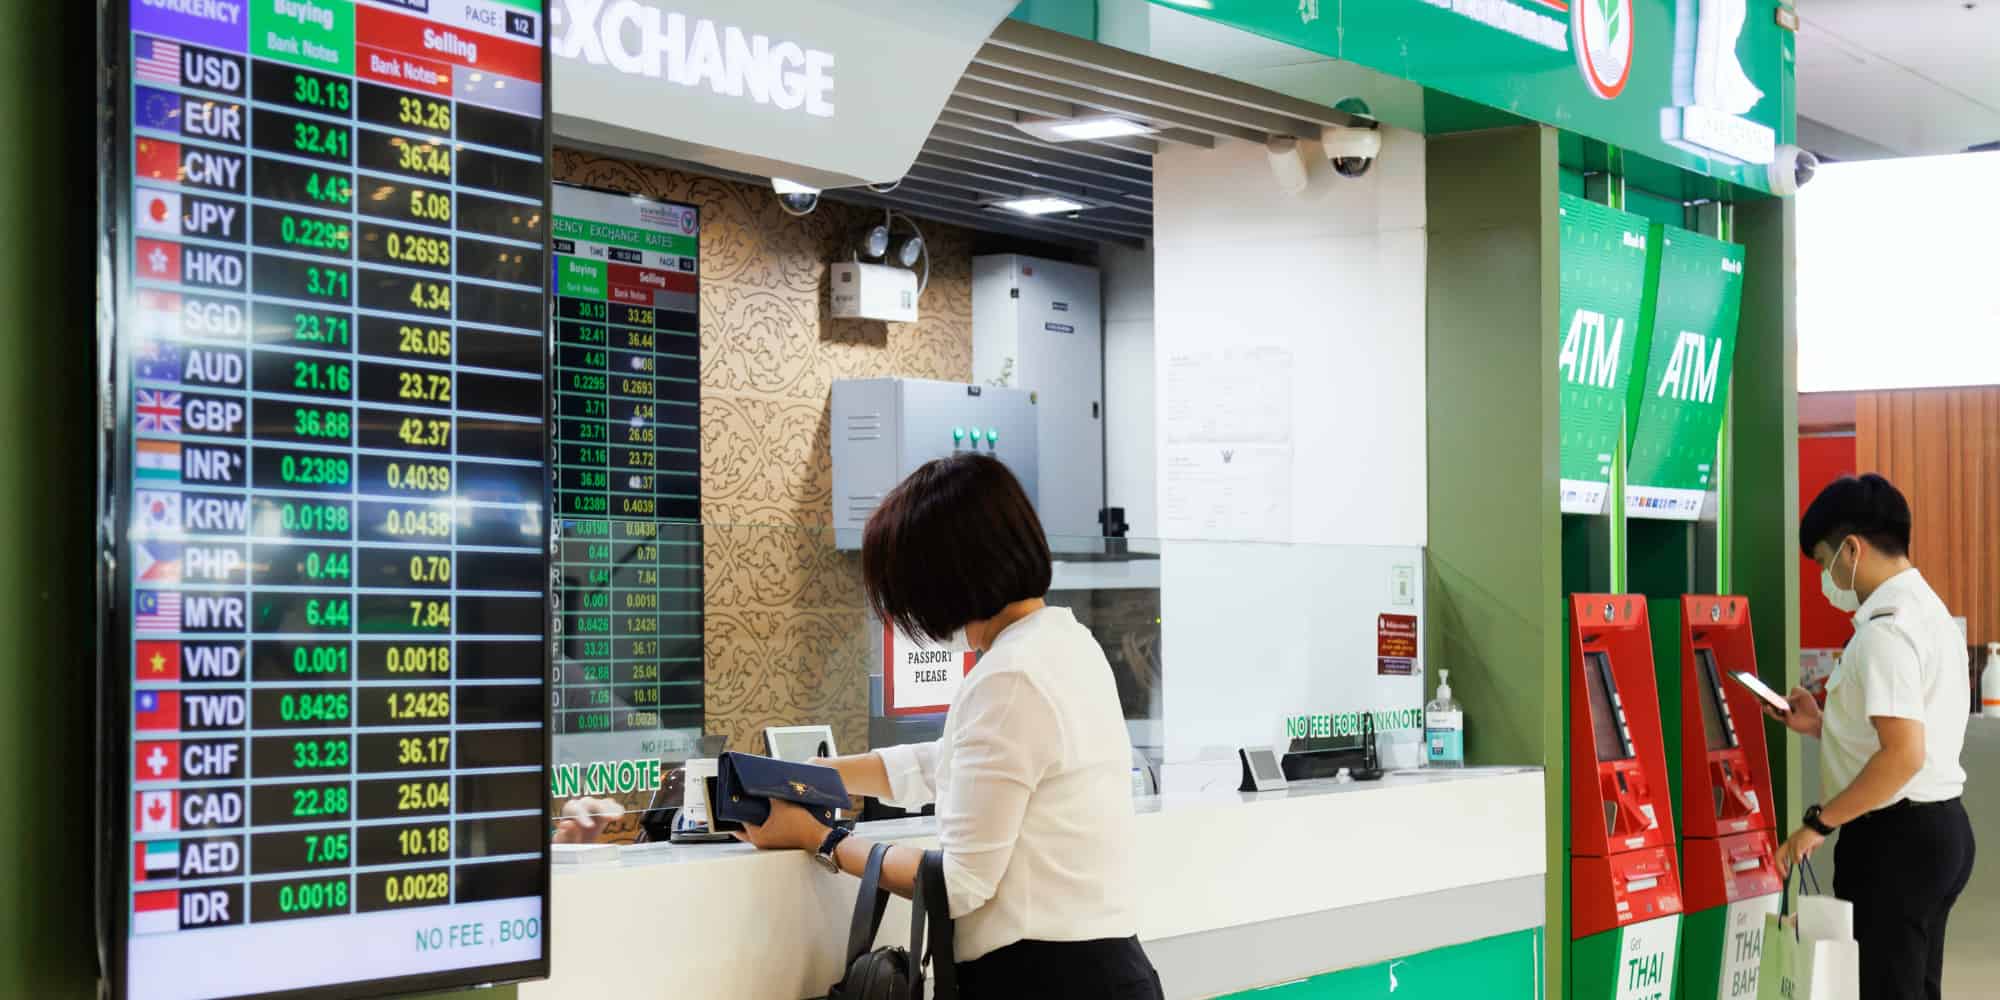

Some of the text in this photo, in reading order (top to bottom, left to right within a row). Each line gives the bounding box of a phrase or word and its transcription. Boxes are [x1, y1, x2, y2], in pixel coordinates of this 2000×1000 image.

[274, 0, 334, 31] Buying
[464, 5, 497, 27] PAGE
[513, 18, 530, 34] 1/2
[268, 32, 339, 64] Bank Notes
[423, 29, 477, 61] Selling
[551, 0, 834, 118] EXCHANGE
[184, 48, 241, 90] USD
[370, 56, 438, 85] Bank Notes
[295, 75, 349, 110] 30.13
[184, 101, 241, 141] EUR
[399, 97, 450, 131] 33.26
[295, 123, 348, 158] 32.41
[184, 153, 241, 189] CNY
[399, 143, 450, 175] 36.44
[306, 173, 349, 205] 4.43
[185, 201, 236, 235] JPY
[410, 190, 450, 221] 5.08
[281, 216, 350, 252] 0.2295
[552, 219, 673, 248] RENCY EXCHANGE RATES
[387, 233, 450, 266] 0.2693
[185, 250, 243, 286] HKD
[307, 267, 349, 299] 3.71
[569, 262, 597, 278] Buying
[640, 272, 666, 287] Selling
[410, 282, 450, 310] 4.34
[579, 302, 605, 318] 30.13
[184, 300, 242, 334] SGD
[294, 313, 349, 345] 23.71
[399, 327, 450, 356] 26.05
[579, 327, 604, 342] 32.41
[1559, 308, 1624, 389] ATM
[185, 350, 243, 384] AUD
[585, 352, 605, 366] 4.43
[1657, 330, 1722, 404] ATM
[294, 361, 350, 391] 21.16
[399, 373, 450, 401] 23.72
[574, 375, 605, 390] 0.2295
[185, 400, 243, 434] GBP
[586, 400, 605, 414] 3.71
[634, 404, 653, 418] 4.34
[294, 409, 350, 439] 36.88
[399, 419, 450, 446] 42.37
[580, 424, 605, 439] 23.71
[281, 456, 349, 484] 0.2389
[629, 452, 654, 466] 23.72
[387, 464, 450, 490] 0.4039
[186, 499, 245, 532] KRW
[282, 503, 349, 533] 0.0198
[387, 509, 449, 536] 0.0438
[185, 548, 240, 579] PHP
[305, 552, 350, 580] 0.44
[410, 556, 450, 582] 0.70
[184, 598, 243, 628] MYR
[305, 599, 350, 627] 6.44
[410, 602, 450, 627] 7.84
[184, 647, 240, 677] VND
[294, 646, 348, 673] 0.001
[387, 647, 450, 673] 0.0018
[908, 650, 952, 664] PASSPORT
[915, 669, 947, 683] PLEASE
[185, 696, 245, 725] TWD
[280, 693, 349, 721] 0.8426
[388, 692, 450, 719] 1.2426
[1287, 716, 1307, 738] NO
[1311, 715, 1331, 736] FEE
[1334, 713, 1357, 735] FOR
[184, 744, 239, 775] CHF
[293, 740, 349, 768] 33.23
[399, 737, 450, 764] 36.17
[184, 793, 241, 826] CAD
[293, 787, 349, 816] 22.88
[398, 783, 450, 810] 25.04
[305, 833, 349, 862] 7.05
[399, 828, 450, 855] 10.18
[183, 842, 240, 875] AED
[279, 880, 348, 912] 0.0018
[386, 872, 450, 903] 0.0028
[184, 891, 229, 924] IDR
[416, 926, 442, 951] NO
[449, 922, 484, 947] FEE
[500, 918, 539, 943] BOO
[1630, 937, 1642, 952] Get
[1735, 928, 1760, 962] THA
[1628, 952, 1664, 991] THAI
